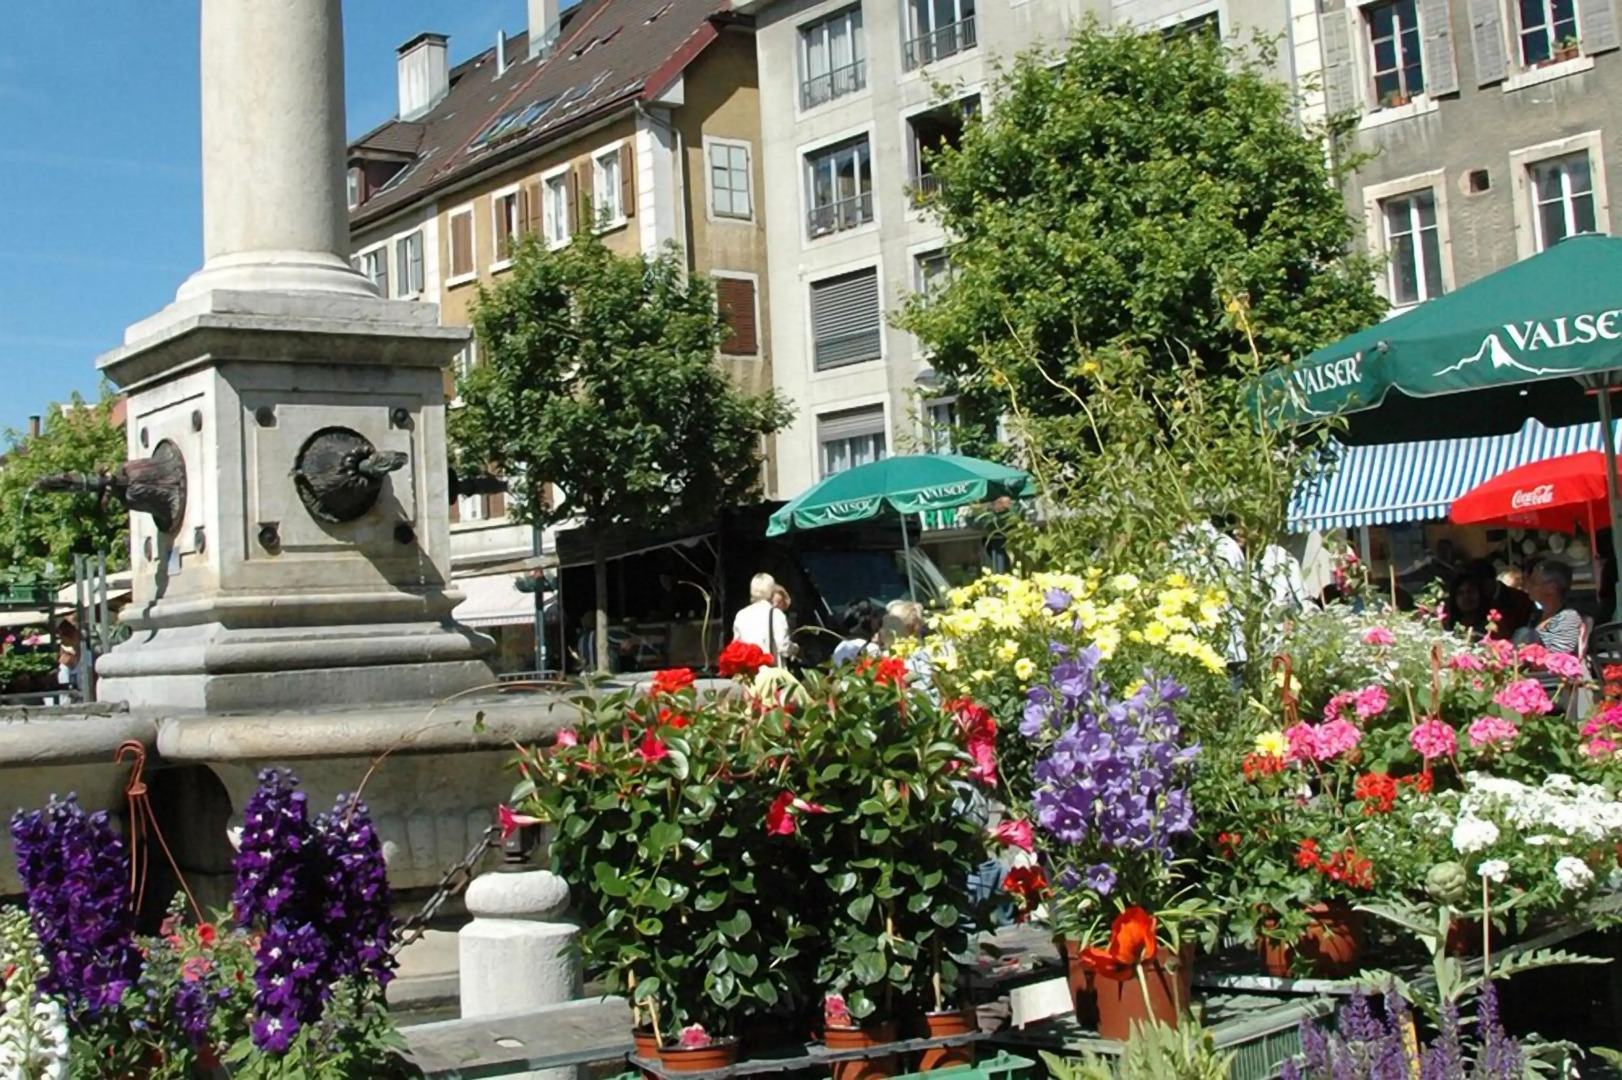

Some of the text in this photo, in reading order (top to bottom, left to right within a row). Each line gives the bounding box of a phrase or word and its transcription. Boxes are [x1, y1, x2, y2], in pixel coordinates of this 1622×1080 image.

[1502, 309, 1622, 351] VALSE
[1293, 356, 1362, 395] VALSER
[922, 483, 967, 500] VALSER
